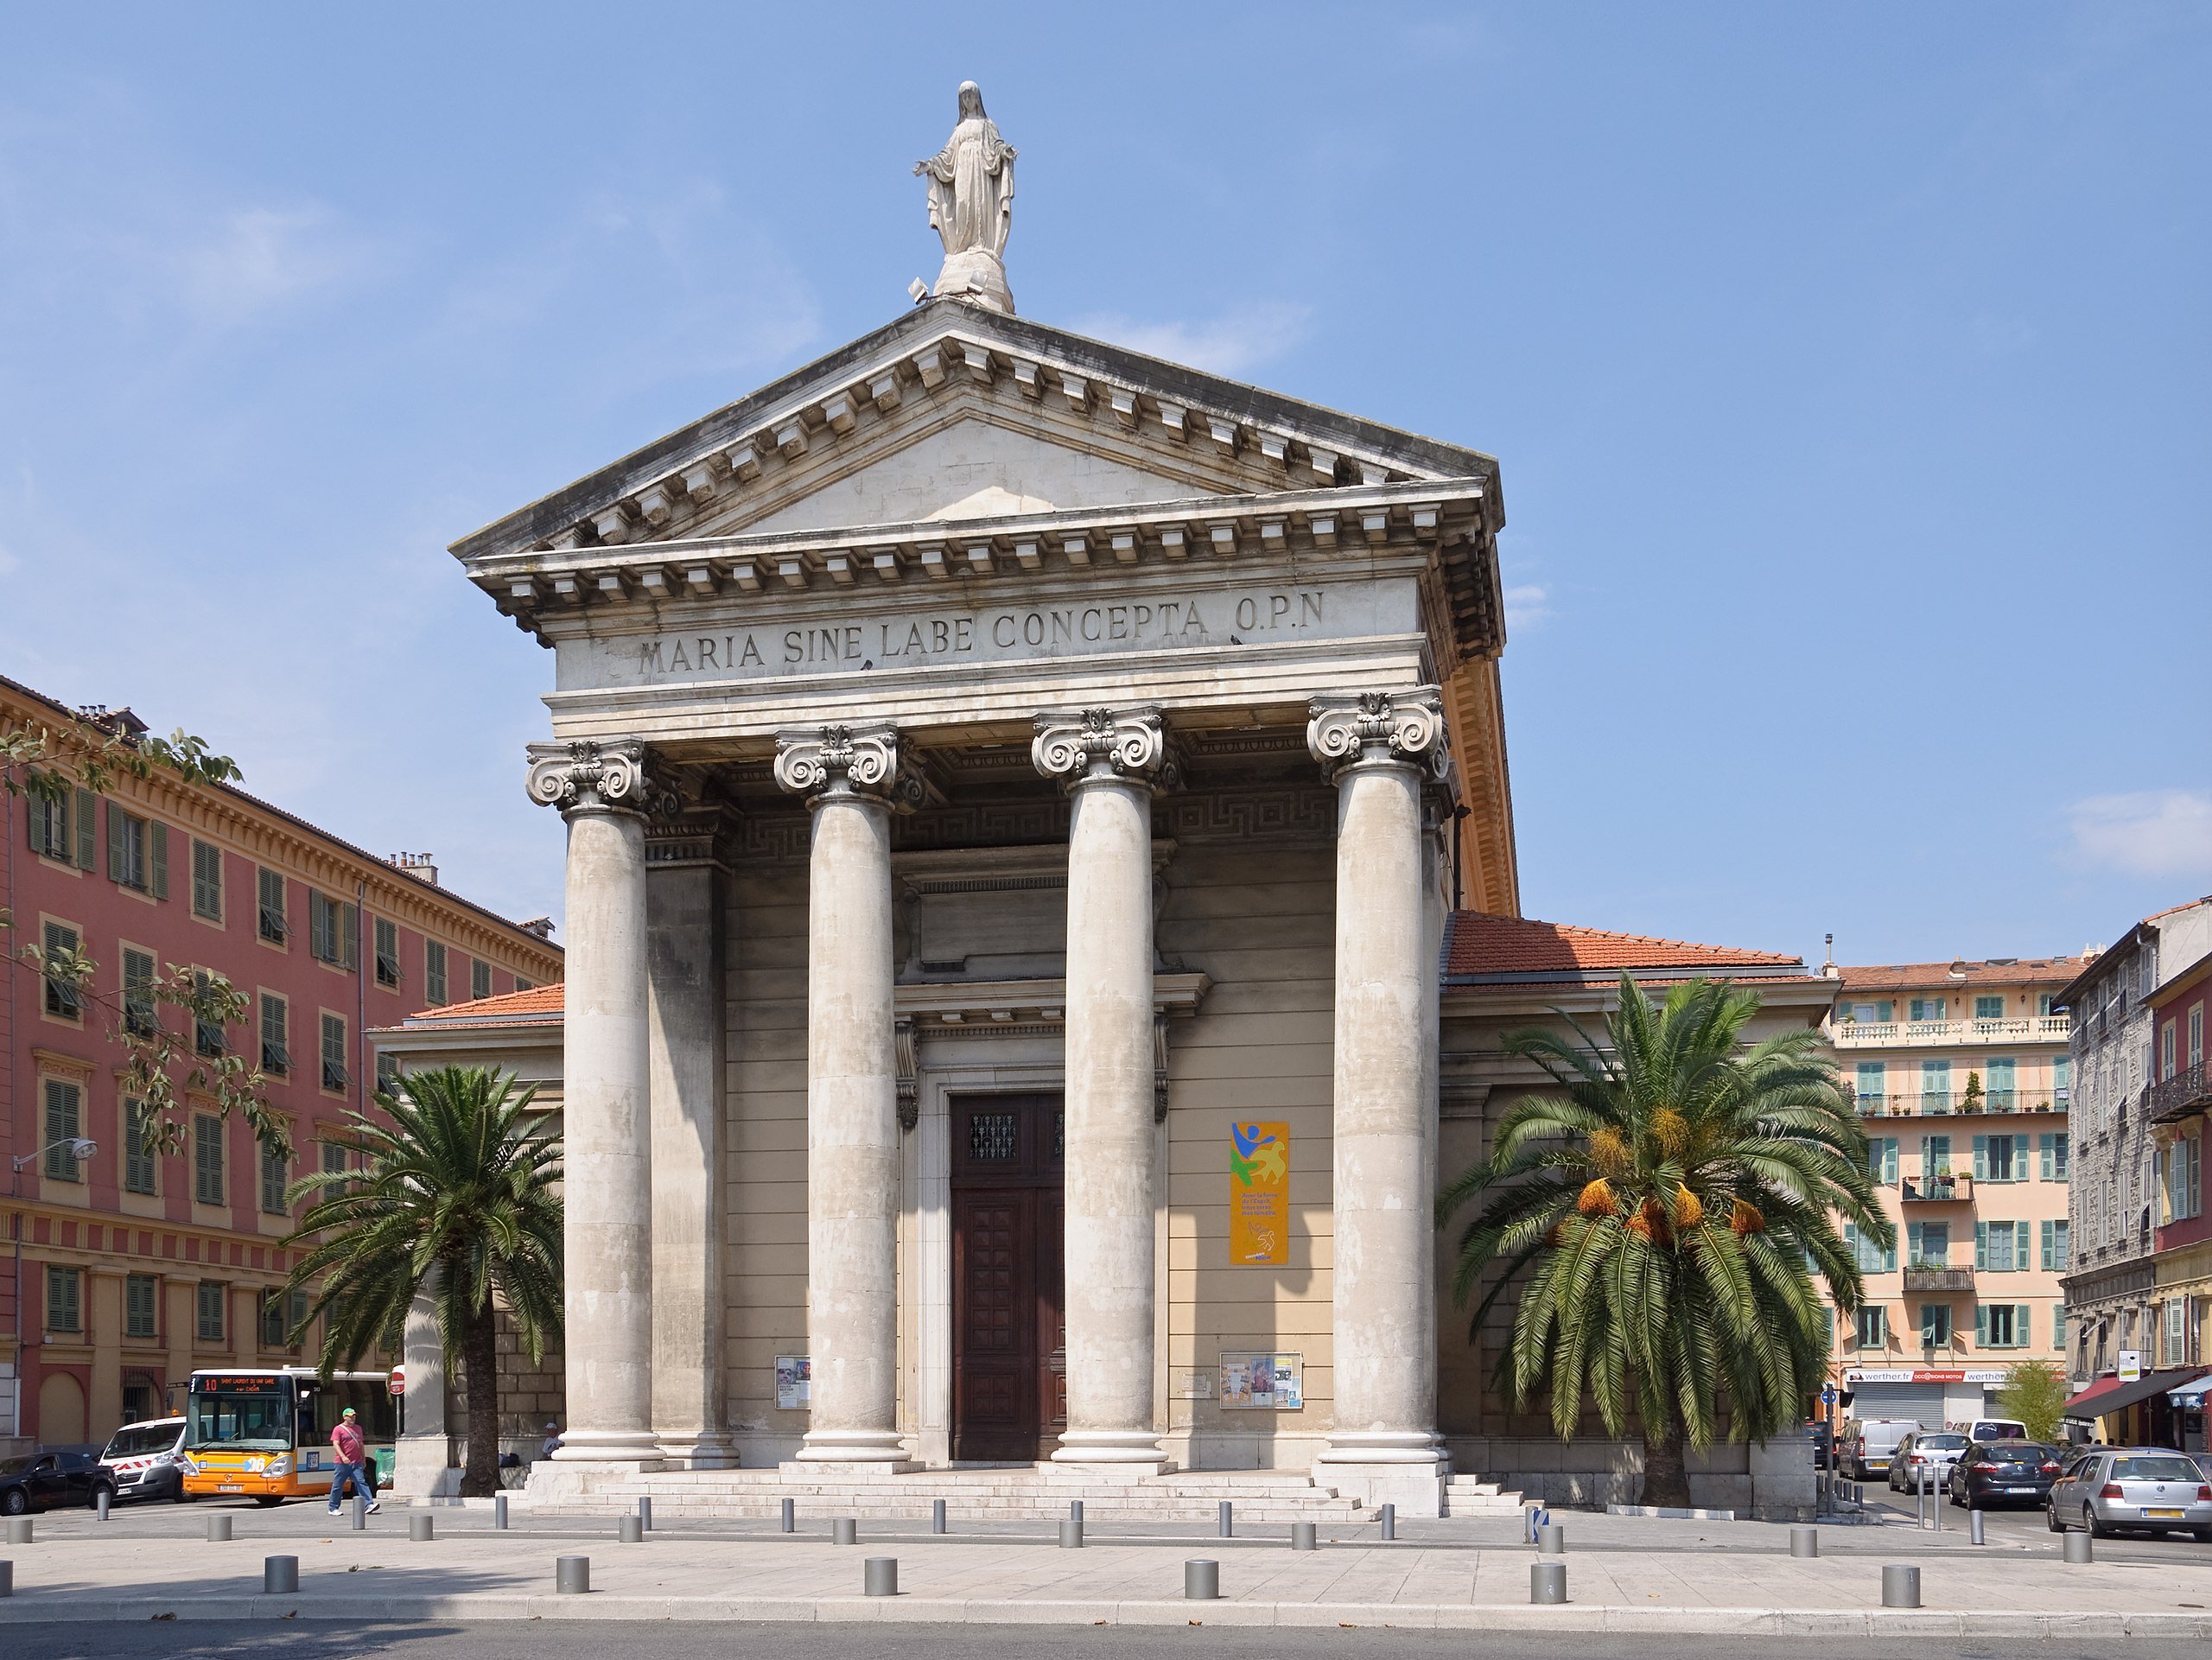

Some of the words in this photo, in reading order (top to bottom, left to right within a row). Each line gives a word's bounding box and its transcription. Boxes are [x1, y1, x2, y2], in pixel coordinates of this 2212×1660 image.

[638, 633, 766, 674] MARIA
[783, 626, 862, 664] SINE
[880, 617, 973, 657] LABE
[993, 600, 1210, 648] CONCEPTA
[1235, 591, 1324, 631] O.P.N
[1865, 1372, 1910, 1381] werther.fr
[205, 1379, 217, 1391] 10
